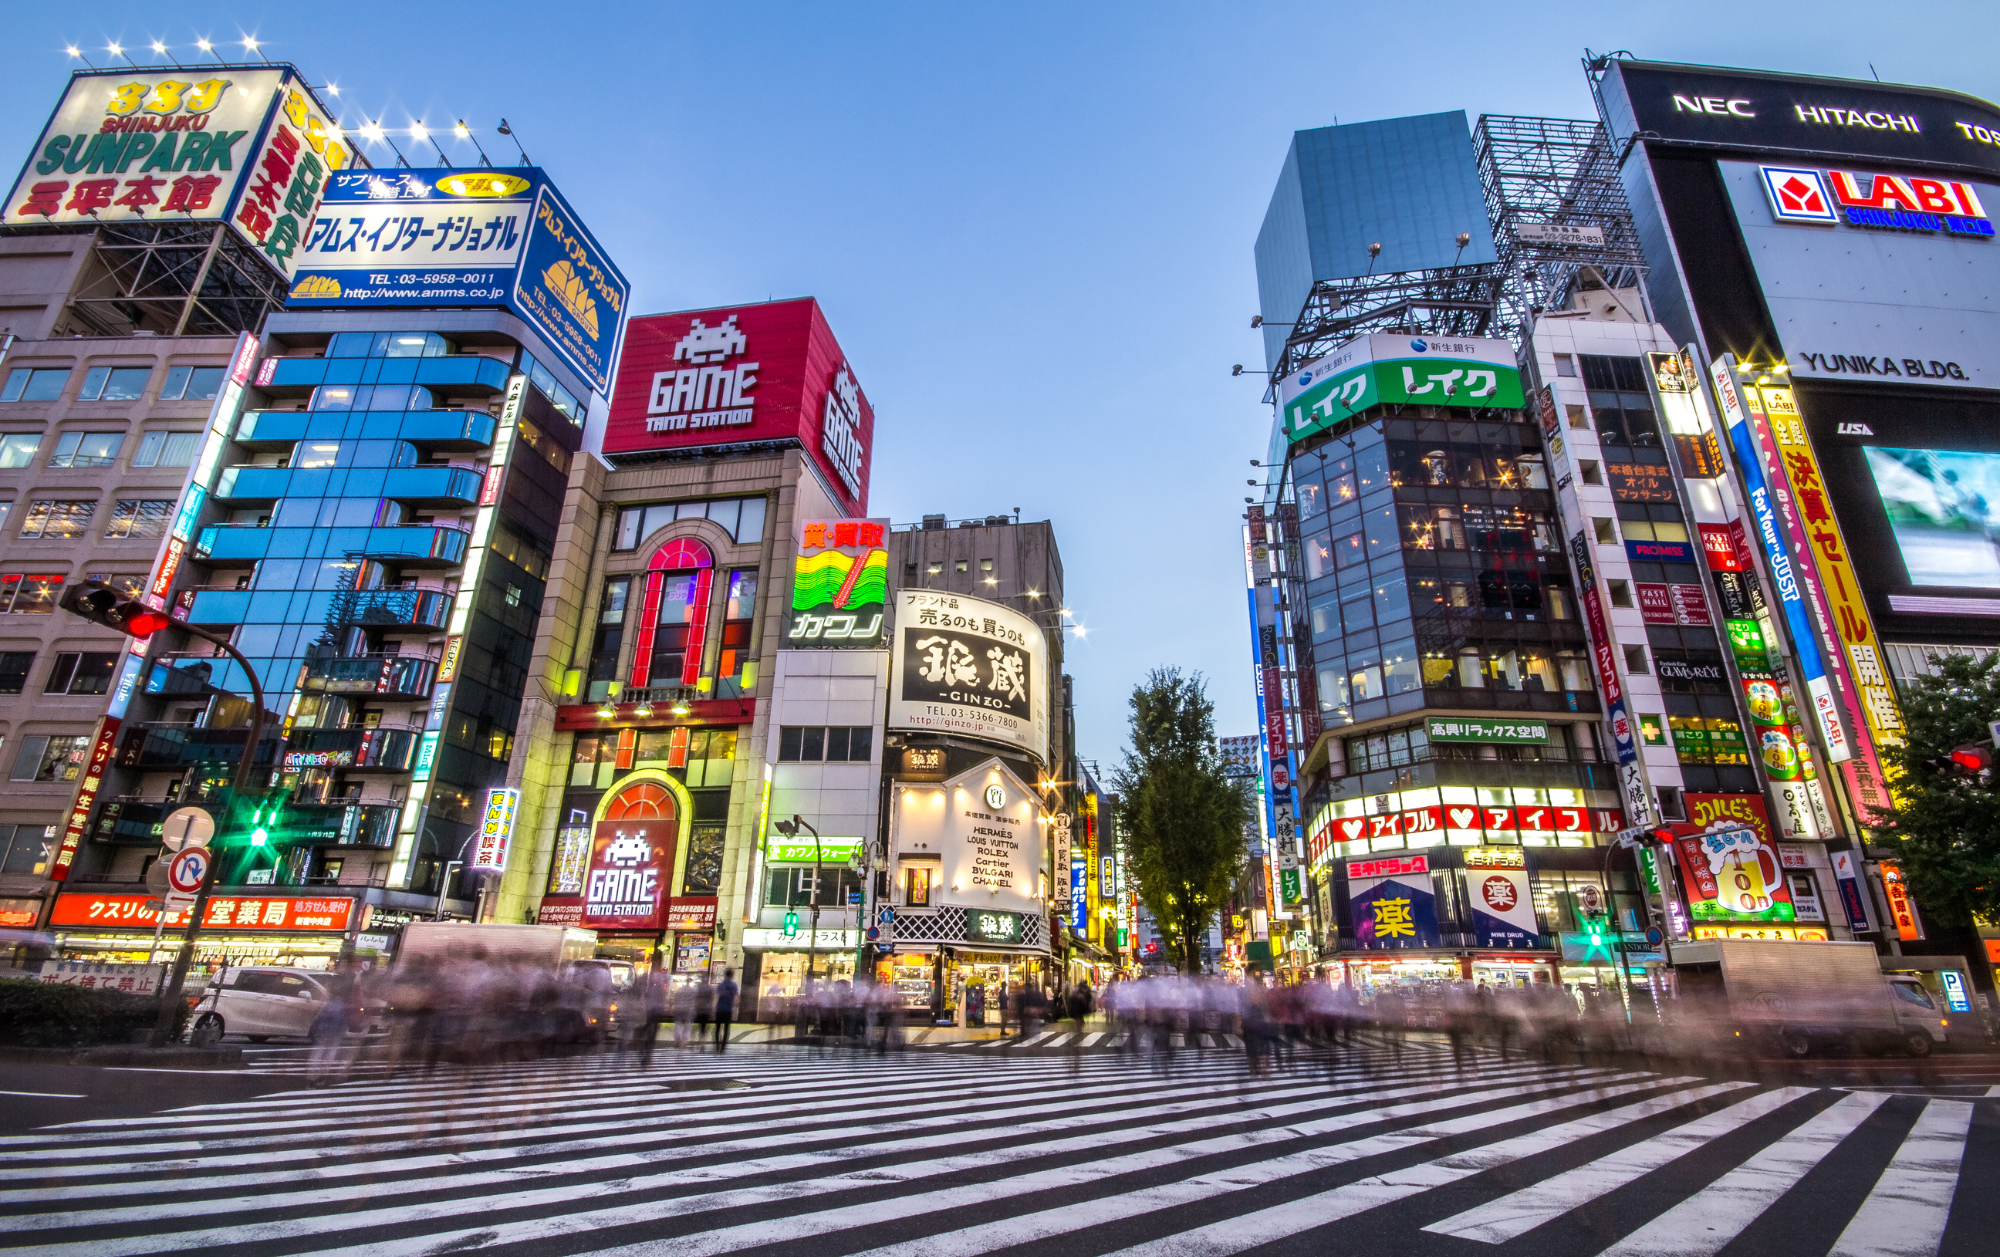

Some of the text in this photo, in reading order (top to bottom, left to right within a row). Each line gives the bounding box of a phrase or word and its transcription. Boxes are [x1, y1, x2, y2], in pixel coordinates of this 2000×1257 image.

[1673, 94, 1755, 117] NEC
[100, 114, 209, 133] SHINJUKU
[1795, 105, 1921, 132] HITACHI
[36, 130, 248, 175] SUNPARK
[18, 174, 222, 216] 三平本館
[237, 124, 300, 242] 三平本館
[1827, 169, 1987, 218] LABI
[265, 151, 323, 273] SUNPARK
[1846, 208, 1942, 231] SHINJUKU
[305, 216, 518, 252] アムス・インターナショナル
[538, 199, 620, 312] アムス・インターナショナル
[344, 287, 504, 299] http://www.amms.co.jp
[551, 284, 593, 333] AMMS GROUP
[518, 285, 606, 385] http://www.amms.co.jp
[1431, 342, 1475, 354] 新生銀行
[1315, 352, 1352, 377] 新生銀行
[1800, 352, 1970, 381] YUNIKA BLDG.
[647, 362, 759, 415] GAME
[1402, 366, 1496, 397] レイク
[1293, 374, 1367, 431] レイク
[1723, 382, 1737, 410] LABI
[1767, 400, 1795, 410] LABI
[646, 408, 753, 432] TAITO STATION
[1837, 422, 1874, 436] LISA
[824, 390, 863, 486] GAME
[1609, 465, 1669, 477] 本格台湾式
[1625, 477, 1658, 488] オイル
[1616, 489, 1672, 500] マッサージ
[1751, 487, 1766, 507] For
[802, 522, 884, 549] 質・買取
[1704, 534, 1728, 542] FAST
[1706, 542, 1731, 551] NAIL
[1636, 545, 1684, 556] PROMISE
[906, 593, 959, 610] ブランド品
[1642, 590, 1664, 598] FAST
[1644, 598, 1667, 606] NAIL
[789, 613, 883, 638] カワノ
[1600, 647, 1619, 700] アイフル
[118, 672, 136, 702] Vitule
[433, 691, 448, 720] Vitule
[926, 705, 1018, 729] TEL.03-5366-7800
[909, 715, 984, 732] http://ginzo.jp
[1270, 715, 1286, 756] アイフル
[1614, 718, 1629, 735] 薬
[1826, 710, 1843, 746] LABI
[1274, 771, 1288, 785] 薬
[1626, 763, 1649, 823] 大勝軒
[479, 794, 504, 864] まんが喫茶
[1276, 807, 1295, 852] 大勝軒
[1370, 810, 1436, 837] アイフル
[1492, 807, 1619, 832] アイフル
[1694, 798, 1767, 841] カルビちゃん
[967, 836, 1018, 849] LOUIS VUITTON
[973, 828, 1013, 839] HERMÈS
[975, 858, 1010, 868] Cartier
[977, 847, 1009, 858] ROLEX
[1473, 854, 1523, 868] ミネドラッグ
[1783, 856, 1806, 866] 修理
[972, 867, 1013, 878] BVLGARI
[1350, 856, 1427, 877] ミネドラッグ
[587, 868, 658, 903] GAME
[973, 877, 1011, 888] CHANEL
[1283, 872, 1298, 899] レイク
[1486, 880, 1514, 906] 薬
[294, 901, 347, 913] 処方せん受付
[586, 903, 653, 916] TAITO STATION
[1847, 882, 1862, 919] PROMISE
[1891, 886, 1911, 927] 吉野家
[1372, 898, 1416, 938] 薬
[1945, 974, 1956, 989] P
